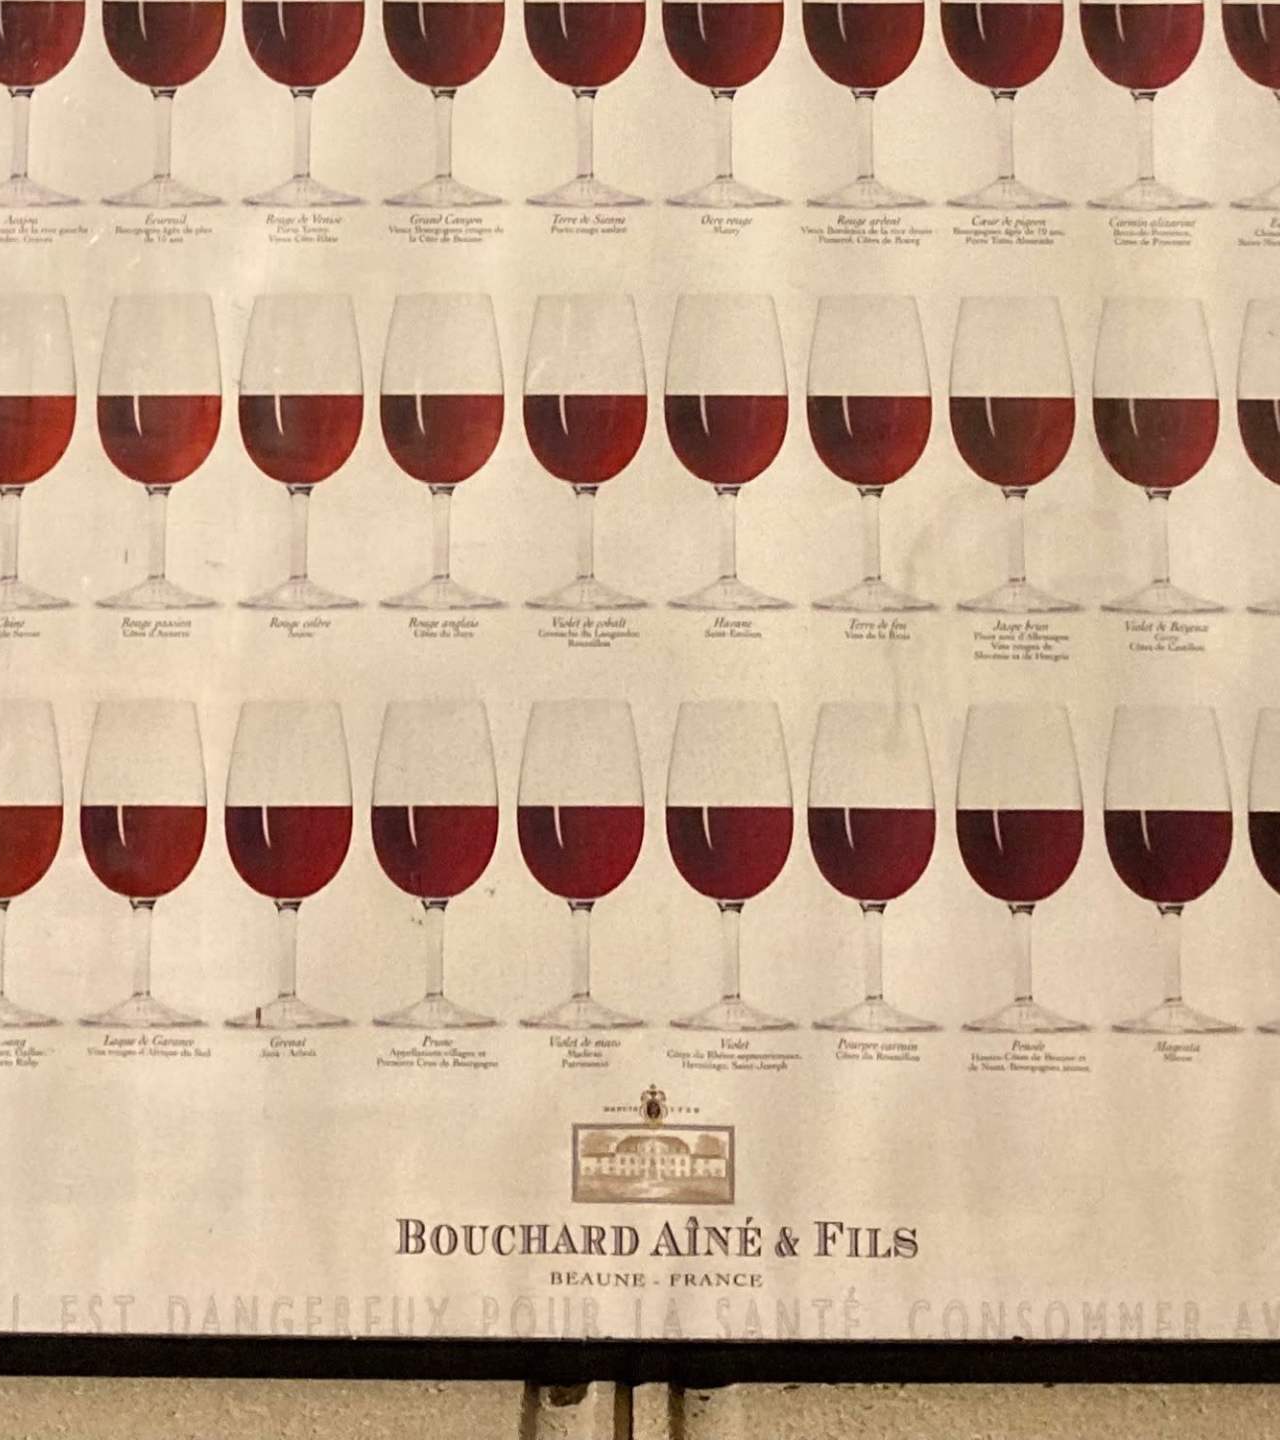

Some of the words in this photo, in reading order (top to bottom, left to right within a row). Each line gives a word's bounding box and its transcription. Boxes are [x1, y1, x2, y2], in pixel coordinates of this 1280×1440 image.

[395, 1218, 639, 1256] BOUCHARD
[650, 1215, 762, 1257] AÎNÉ
[775, 1227, 800, 1257] &
[813, 1220, 920, 1258] FILS
[550, 1271, 646, 1288] BEAUNE
[669, 1273, 763, 1288] FRANCE
